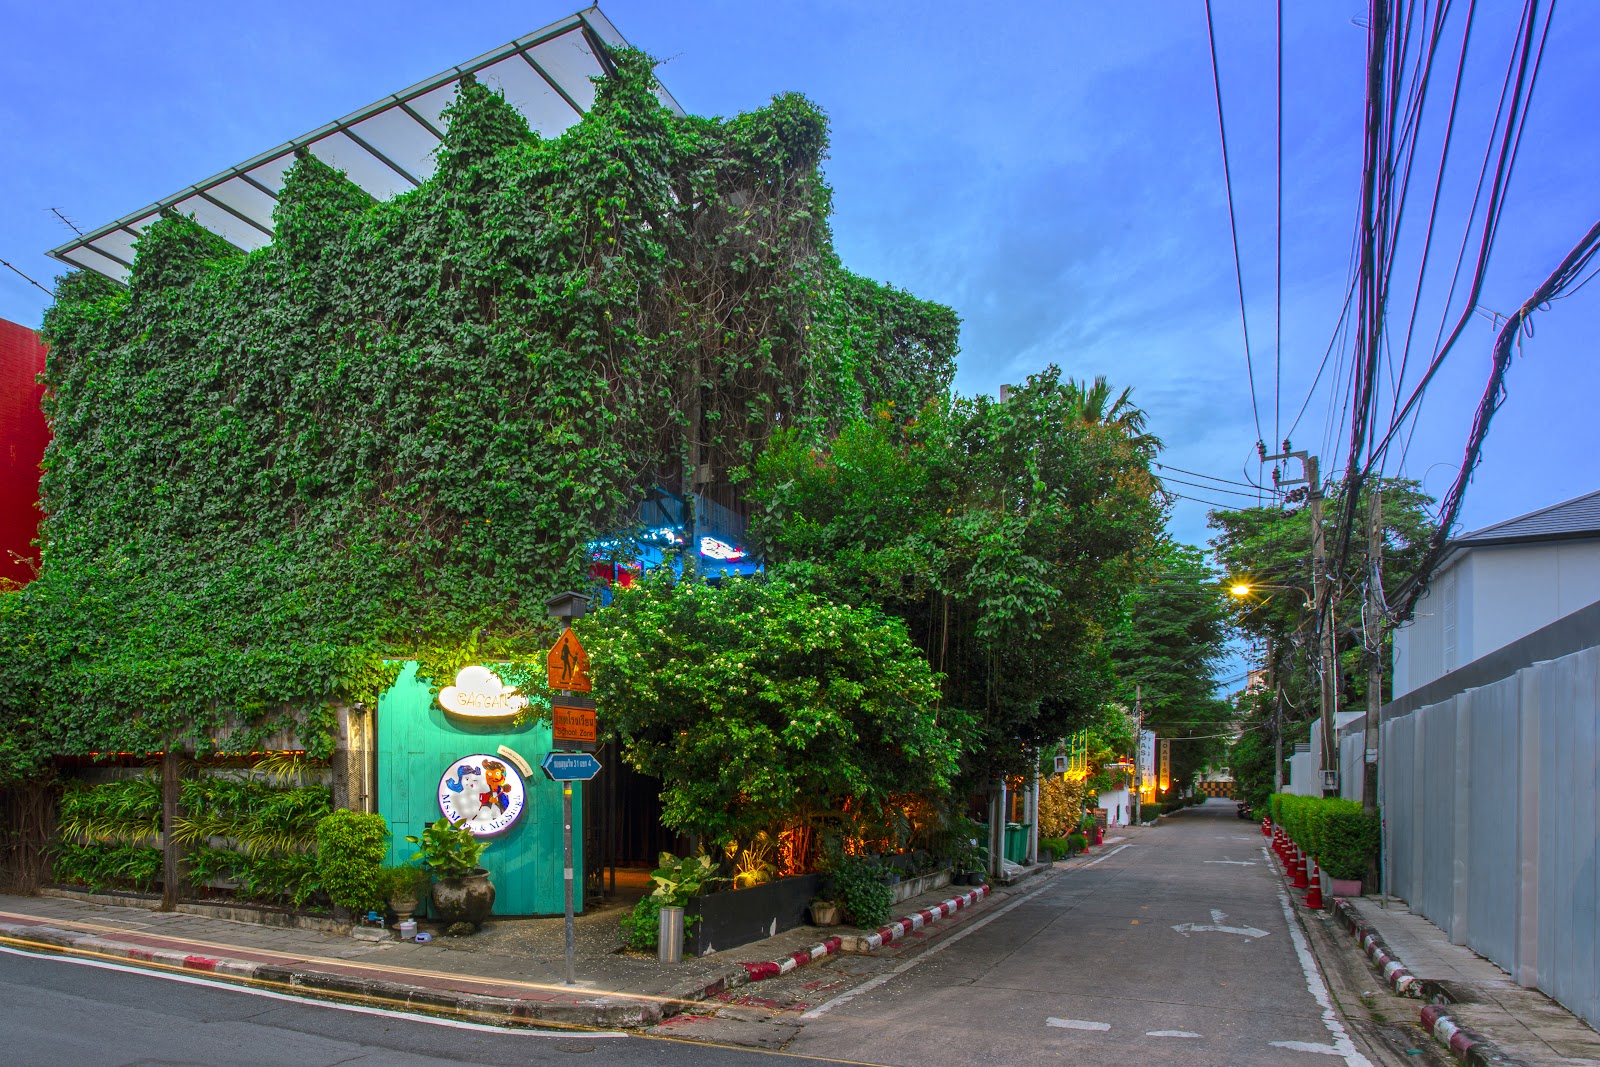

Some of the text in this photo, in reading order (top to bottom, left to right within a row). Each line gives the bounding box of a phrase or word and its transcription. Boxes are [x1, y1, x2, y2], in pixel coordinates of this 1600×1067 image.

[456, 691, 509, 709] GAGGAN
[557, 727, 593, 738] School Zone
